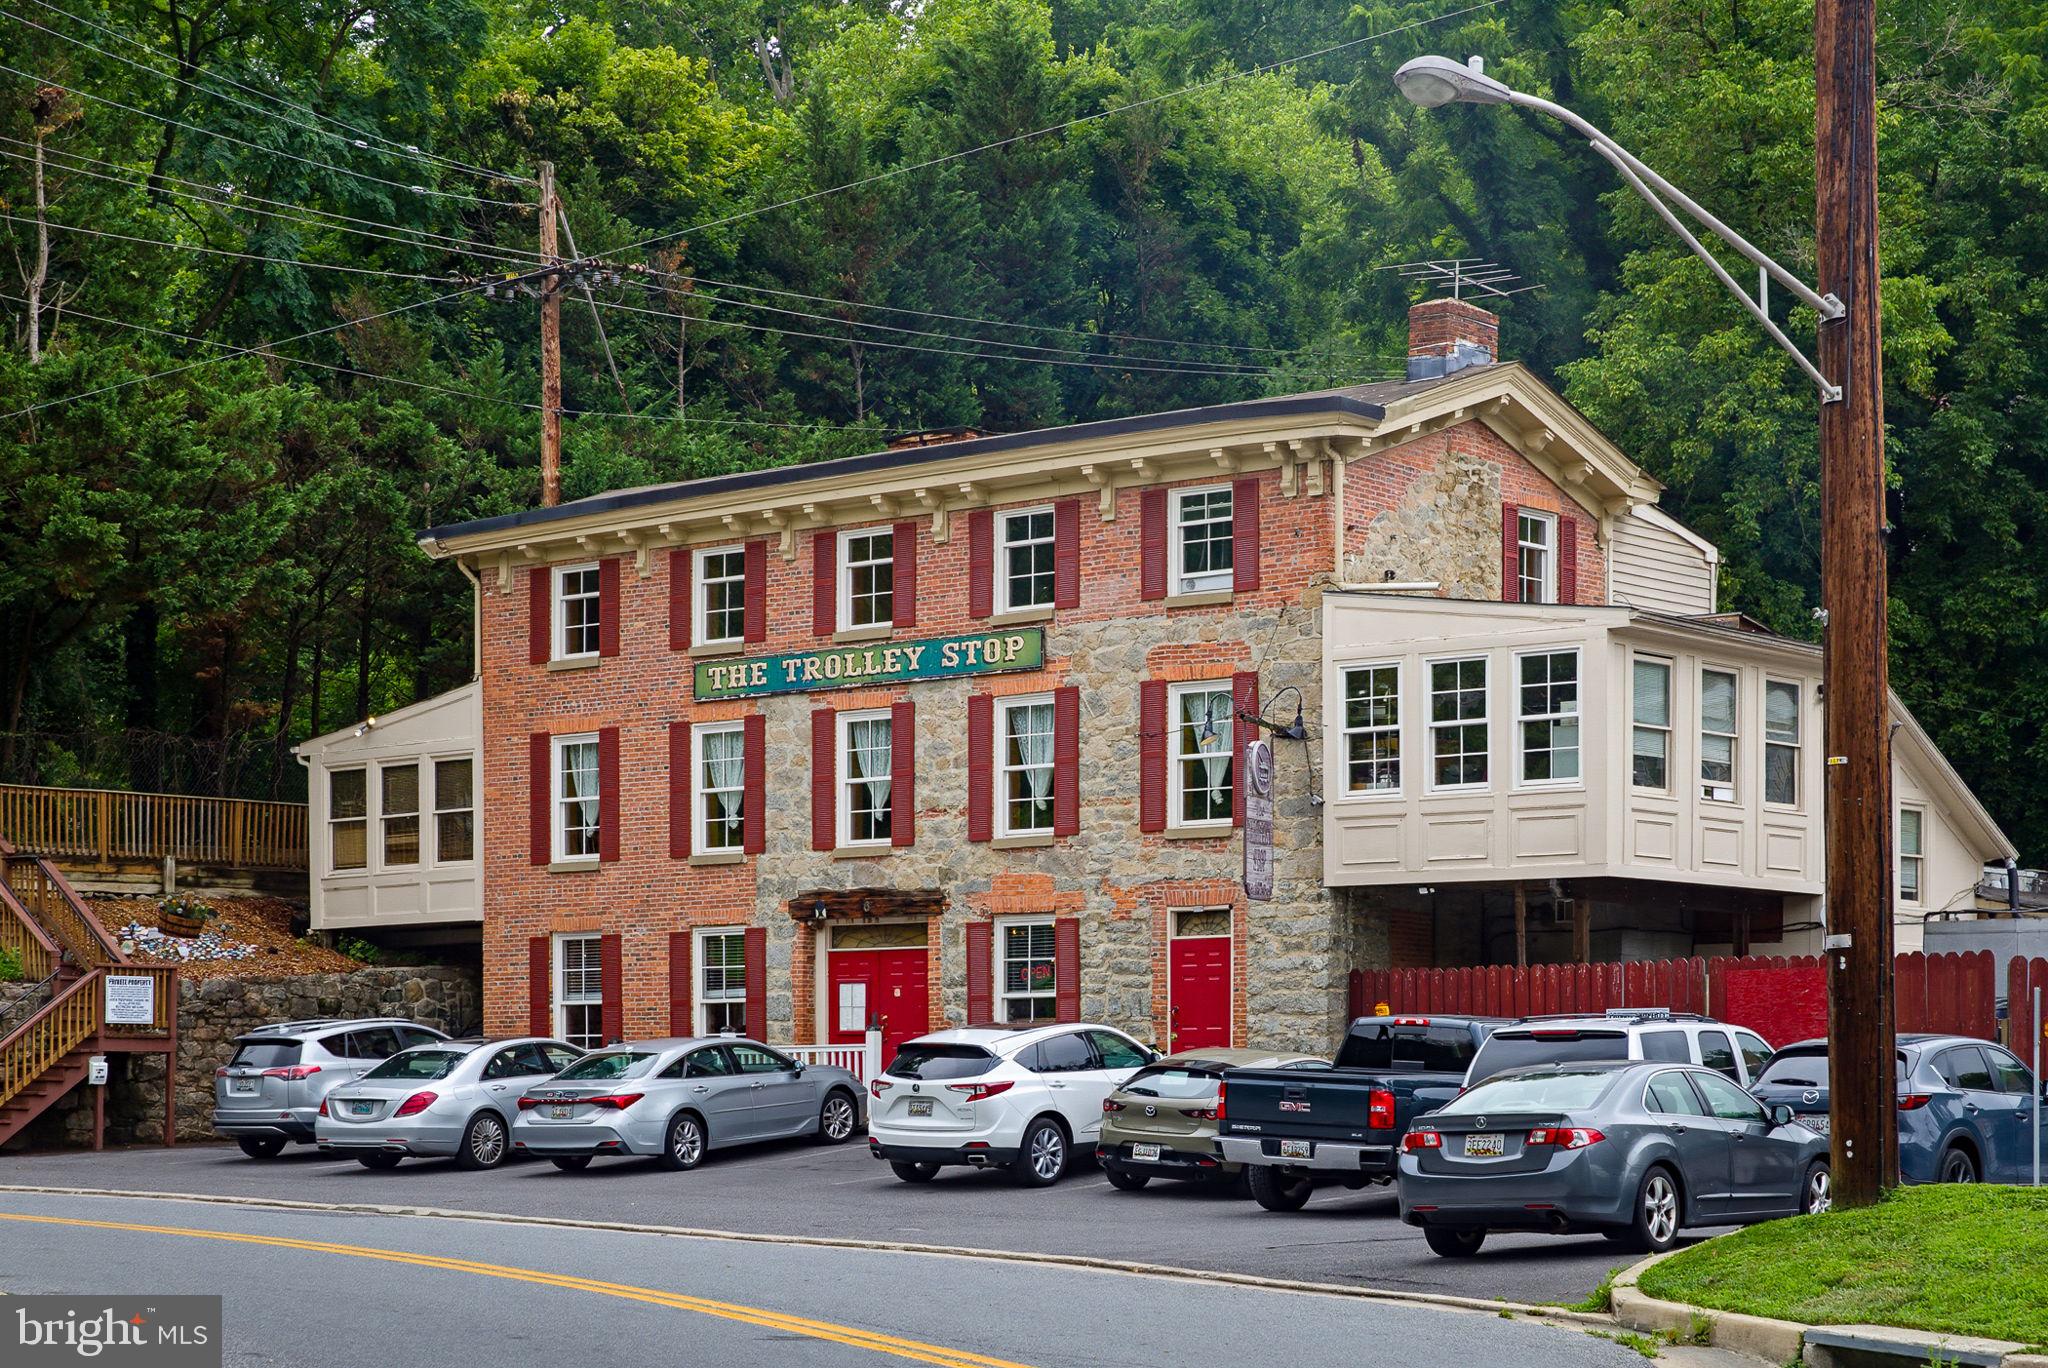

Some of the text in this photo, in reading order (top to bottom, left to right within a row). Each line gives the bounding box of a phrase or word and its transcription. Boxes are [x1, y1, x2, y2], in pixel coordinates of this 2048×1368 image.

[708, 636, 1025, 690] THE TROLLEY STOP
[1020, 965, 1050, 980] OPEN
[1279, 1101, 1311, 1113] GMC
